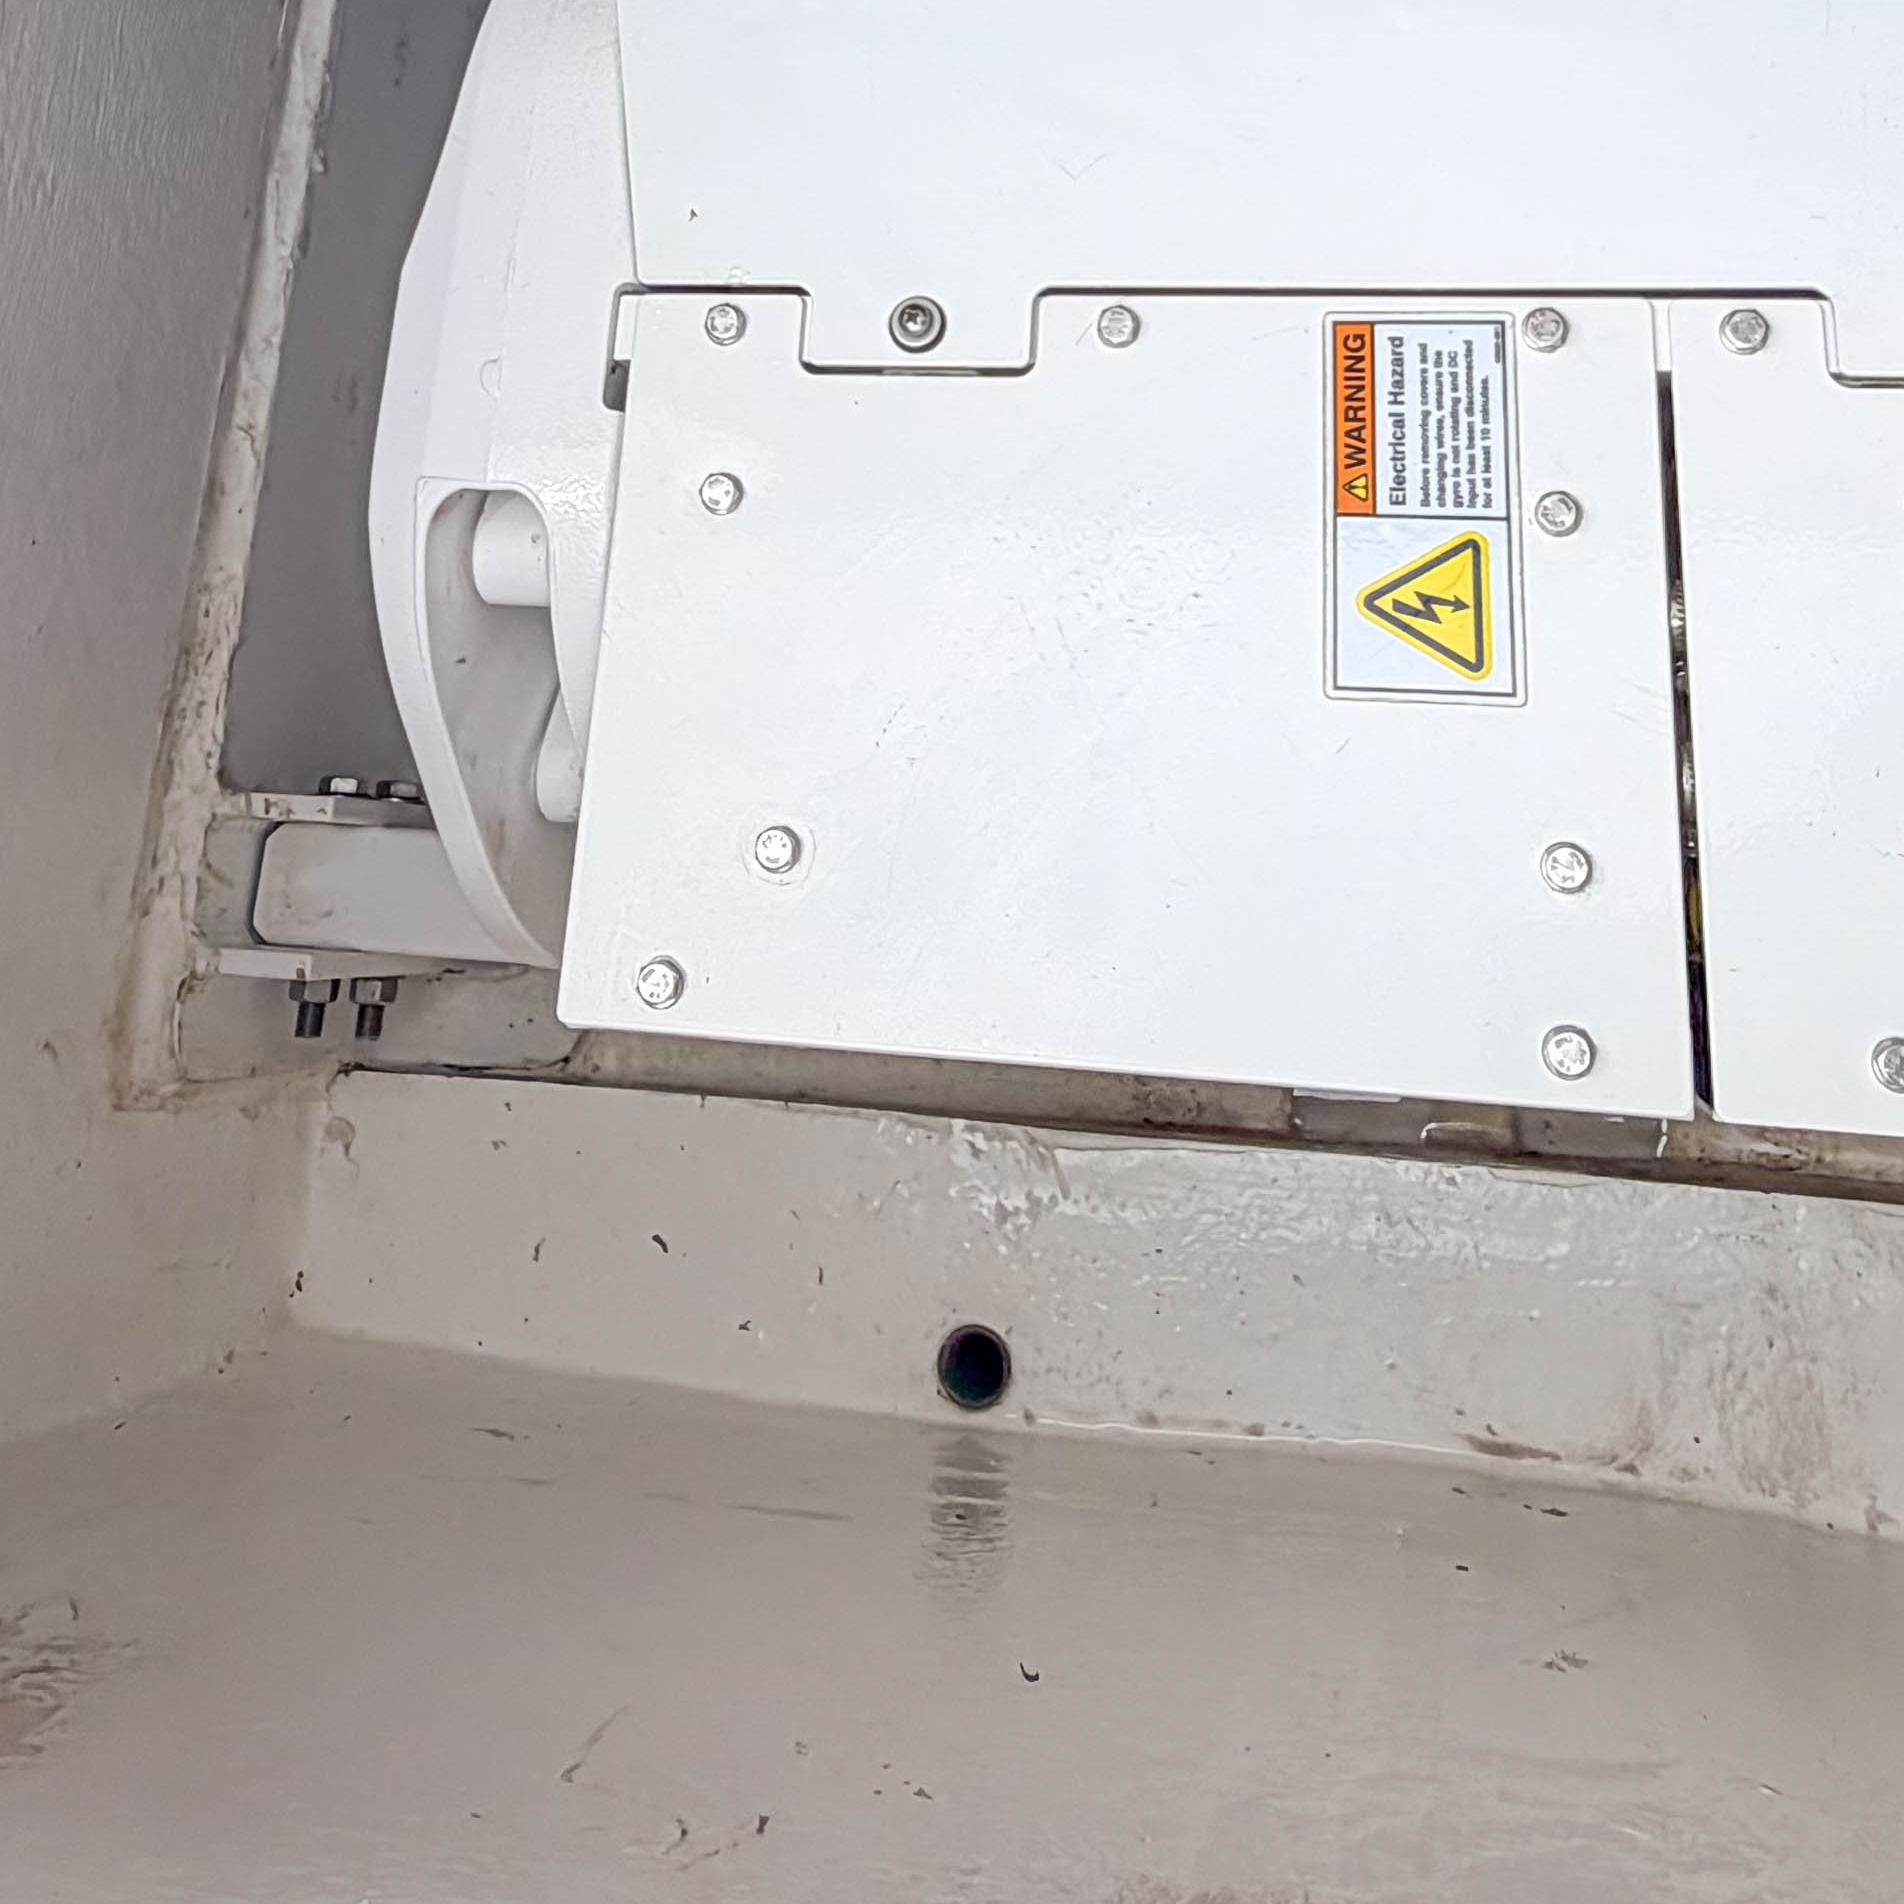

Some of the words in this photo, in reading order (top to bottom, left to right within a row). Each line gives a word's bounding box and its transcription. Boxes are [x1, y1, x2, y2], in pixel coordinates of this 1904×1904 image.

[1417, 343, 1427, 364] and
[1434, 351, 1442, 368] the
[1448, 351, 1457, 368] DC
[1387, 336, 1404, 405] Hazard
[1449, 371, 1458, 393] and
[1343, 334, 1366, 469] WARNING
[1450, 397, 1461, 441] rotating
[1419, 410, 1431, 464] removing
[1466, 421, 1475, 450] been
[1480, 428, 1490, 441] 10
[1388, 412, 1406, 506] Electrical
[1451, 445, 1460, 464] not
[1466, 454, 1476, 474] has
[1481, 446, 1491, 473] least
[1450, 468, 1460, 477] is
[1482, 478, 1491, 489] at
[1420, 468, 1430, 507] Before
[1453, 482, 1463, 508] gyro
[1482, 493, 1492, 508] for
